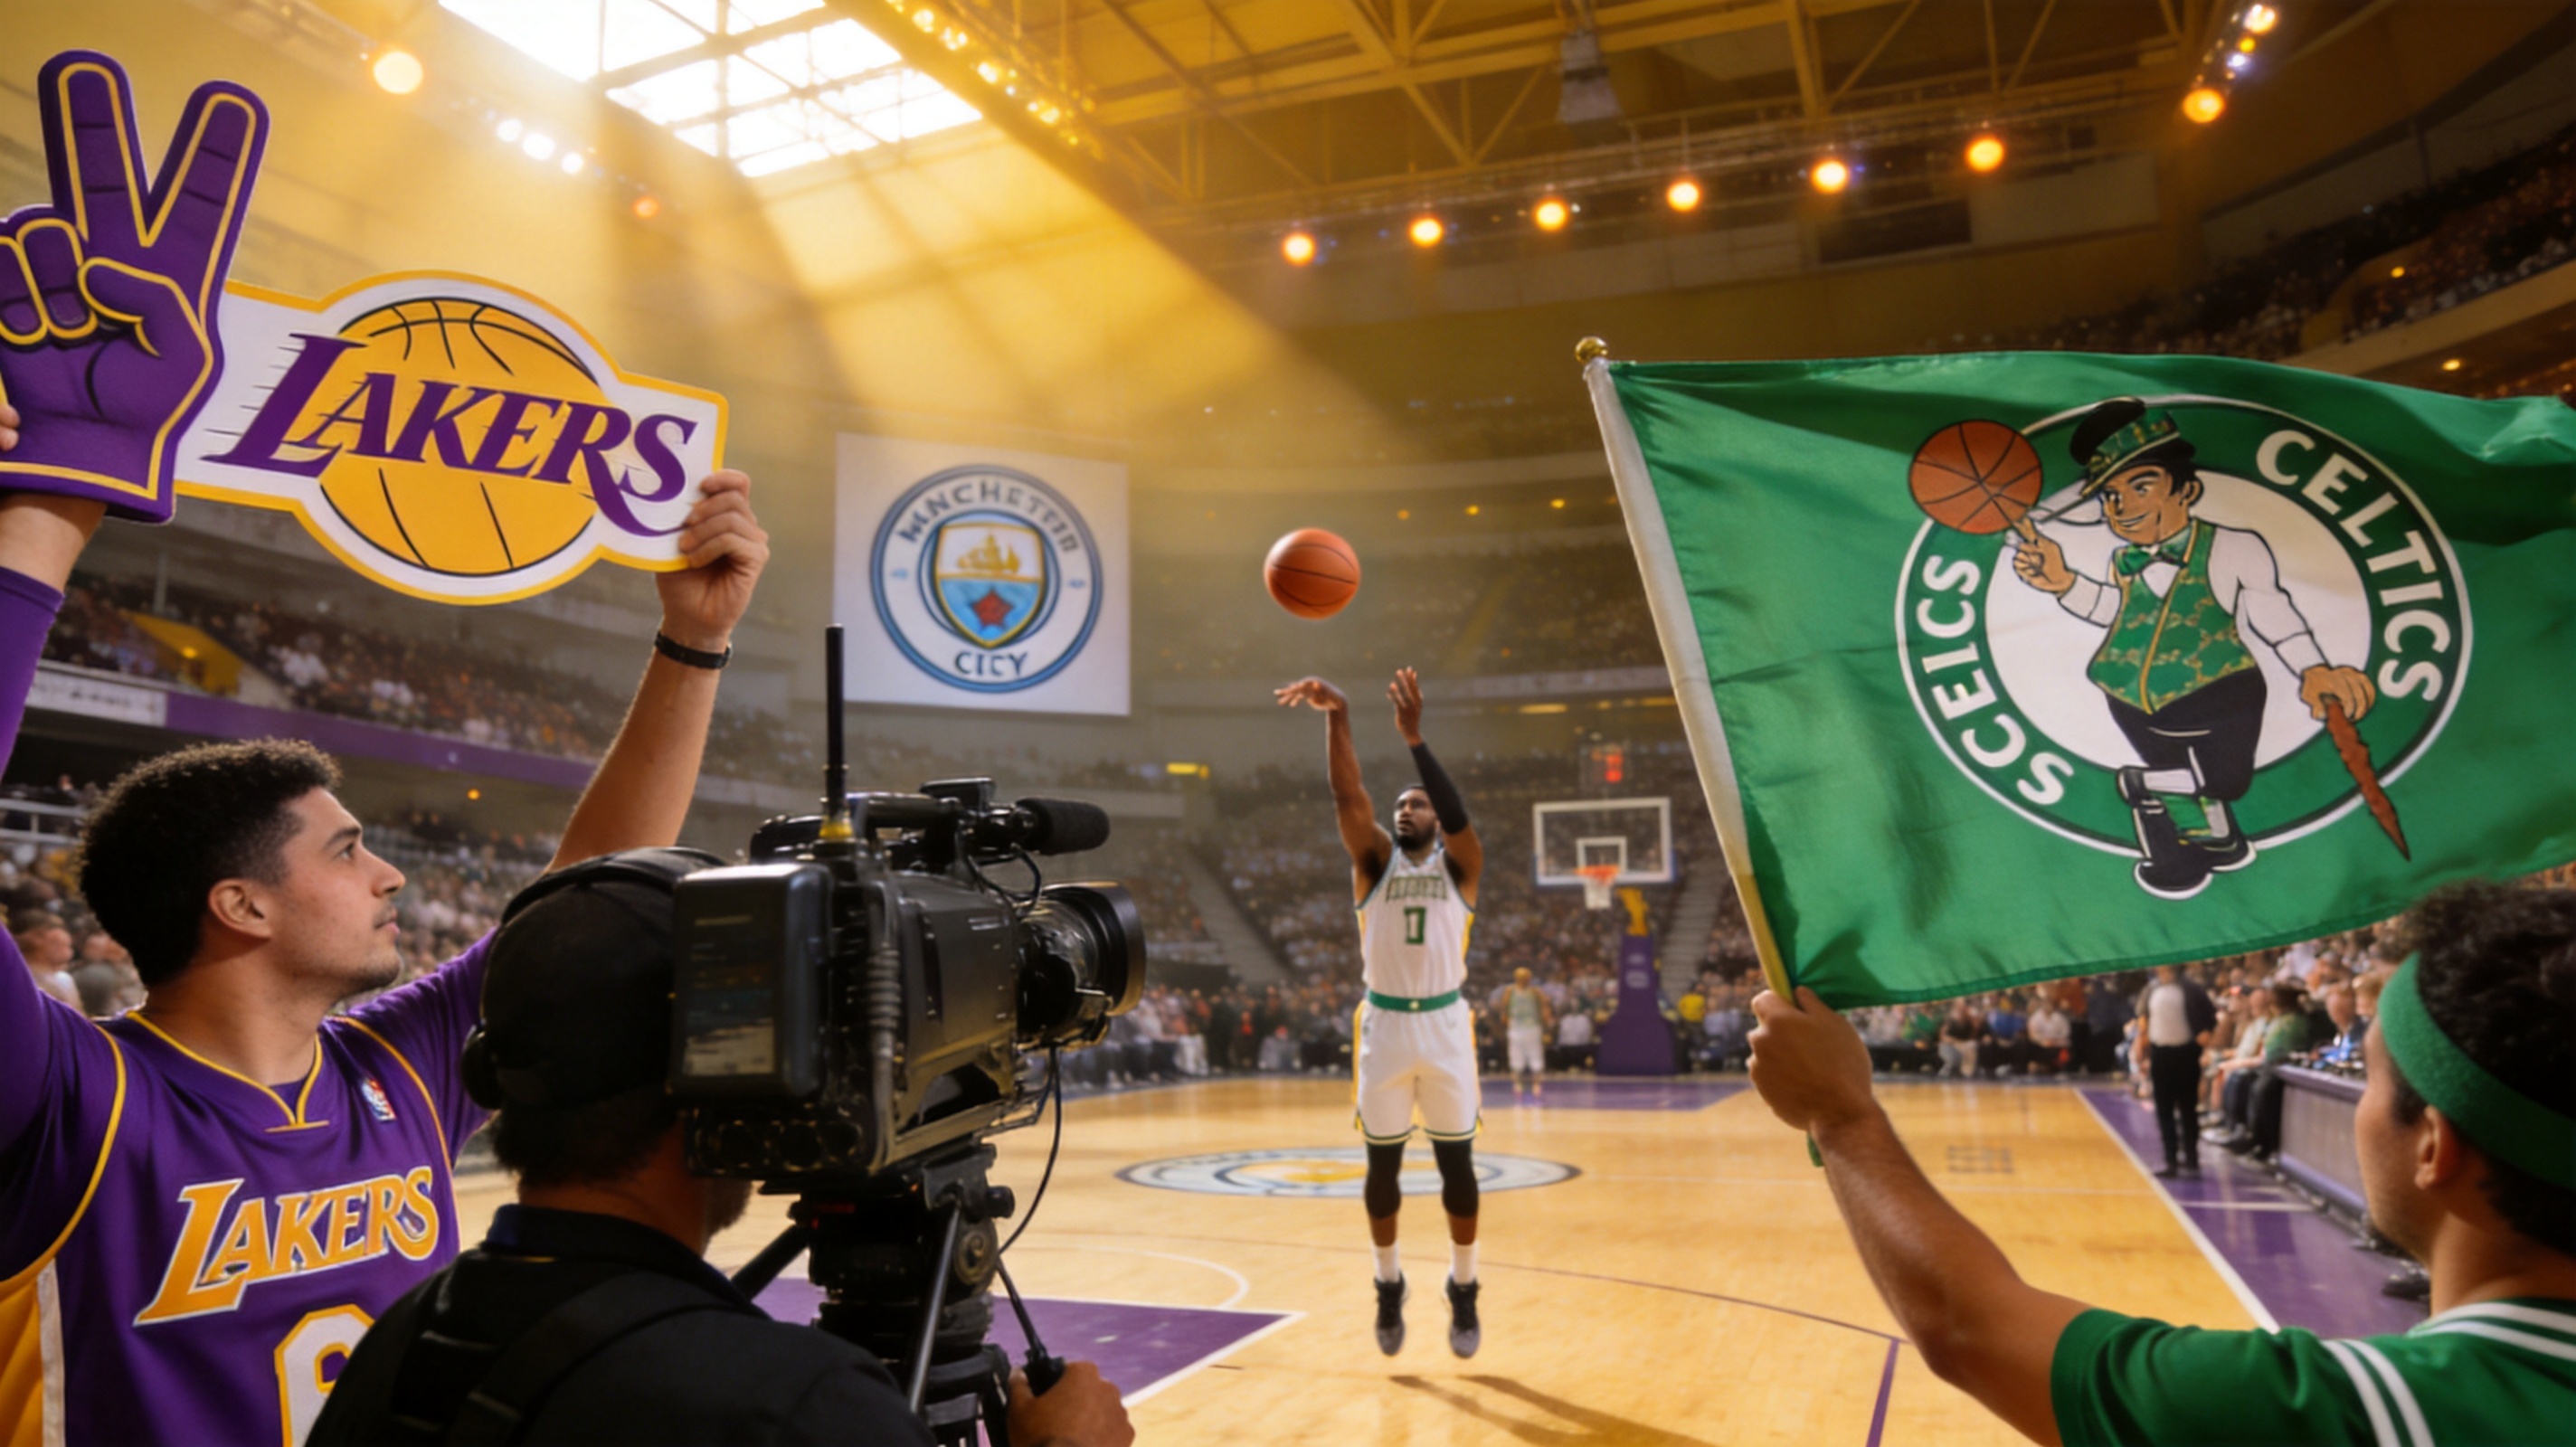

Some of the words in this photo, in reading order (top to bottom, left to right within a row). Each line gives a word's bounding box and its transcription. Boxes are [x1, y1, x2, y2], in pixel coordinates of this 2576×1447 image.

[199, 332, 698, 538] LAKERS
[2255, 429, 2452, 702] CELTICS
[954, 650, 1029, 677] CITY
[133, 1166, 440, 1327] LAKERS
